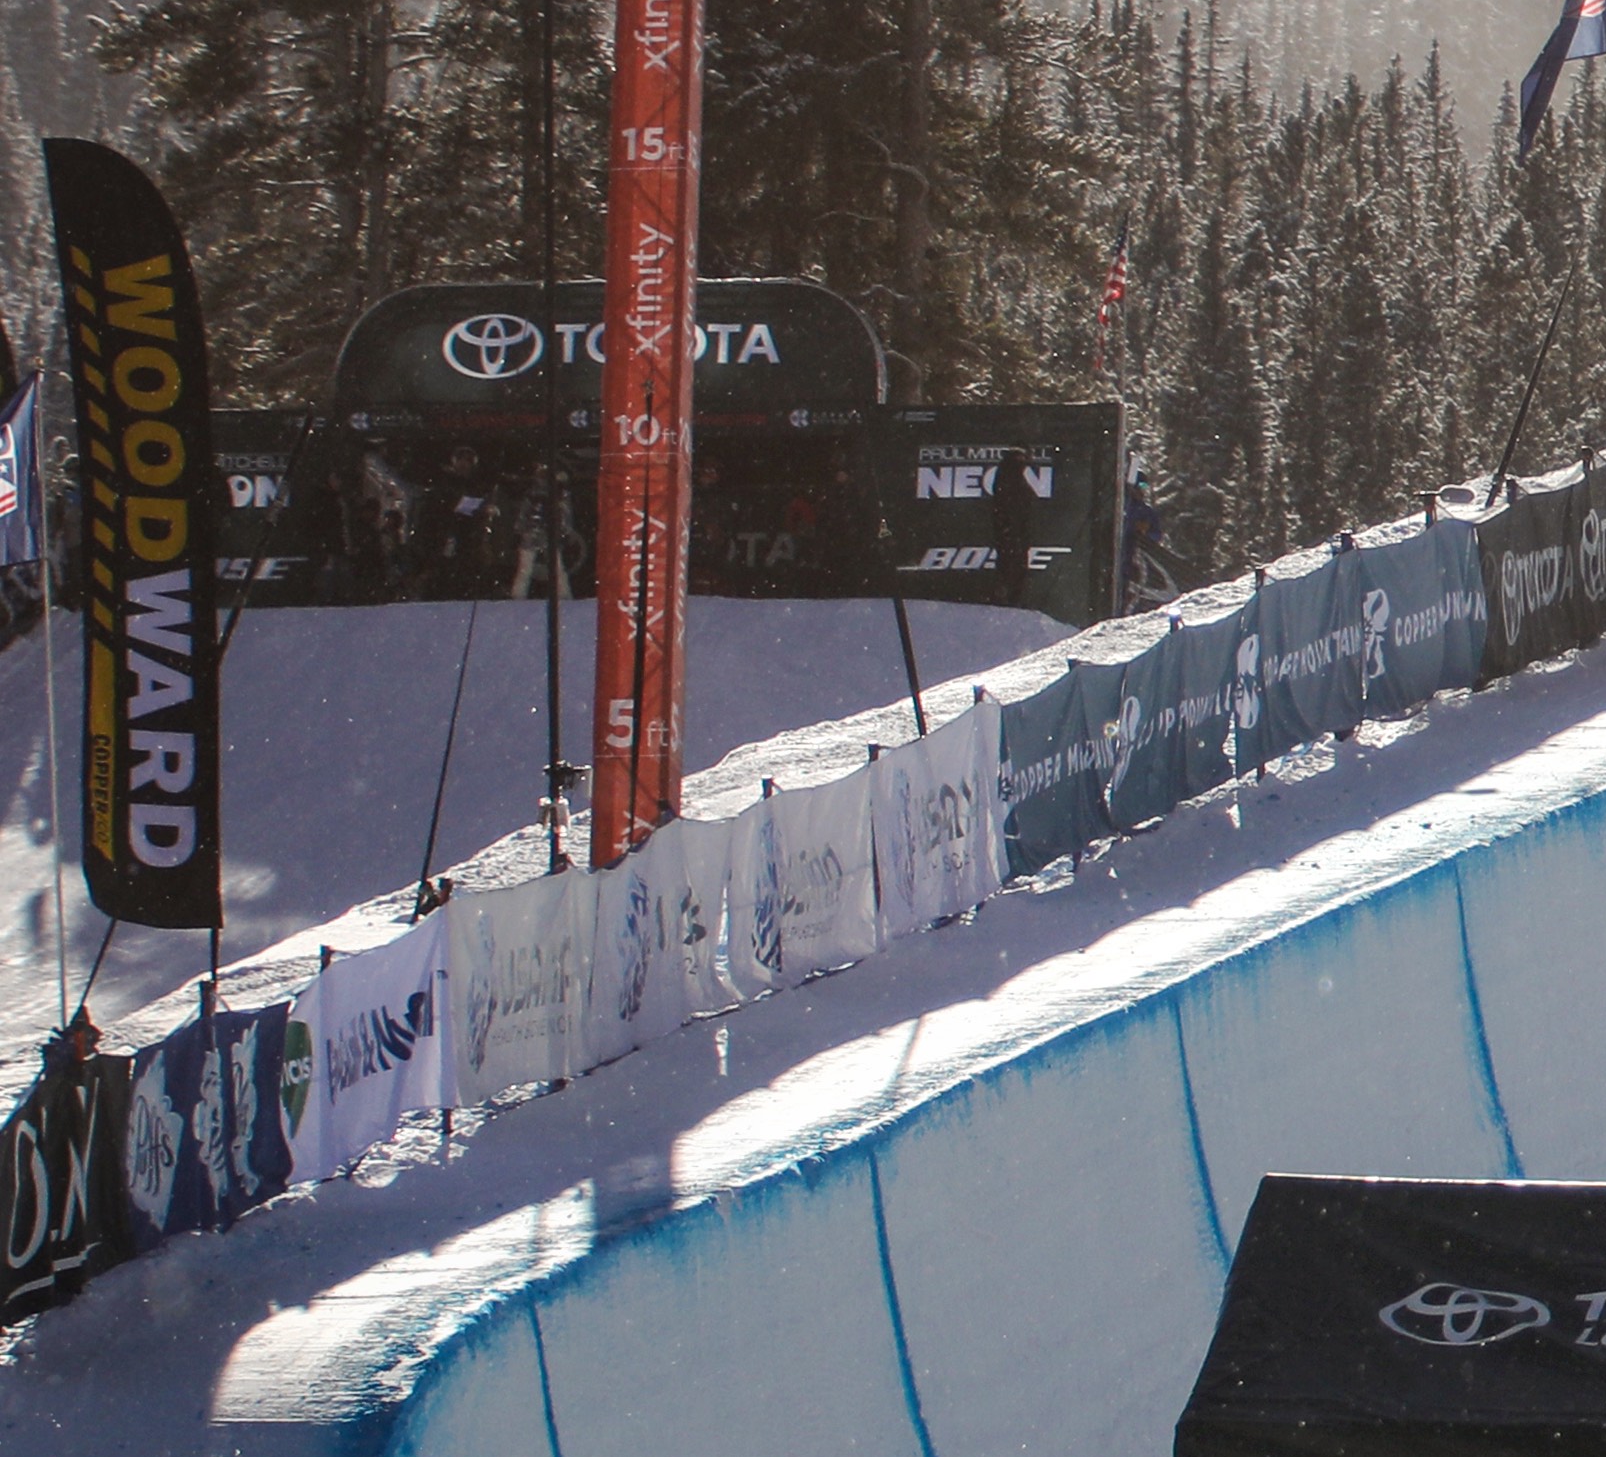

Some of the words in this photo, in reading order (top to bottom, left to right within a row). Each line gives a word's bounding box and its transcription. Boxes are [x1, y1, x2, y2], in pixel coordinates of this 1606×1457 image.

[619, 127, 666, 162] 15
[625, 222, 675, 358] xfinity
[613, 414, 661, 445] 10
[103, 252, 198, 869] WOODWARD
[605, 698, 635, 748] 5
